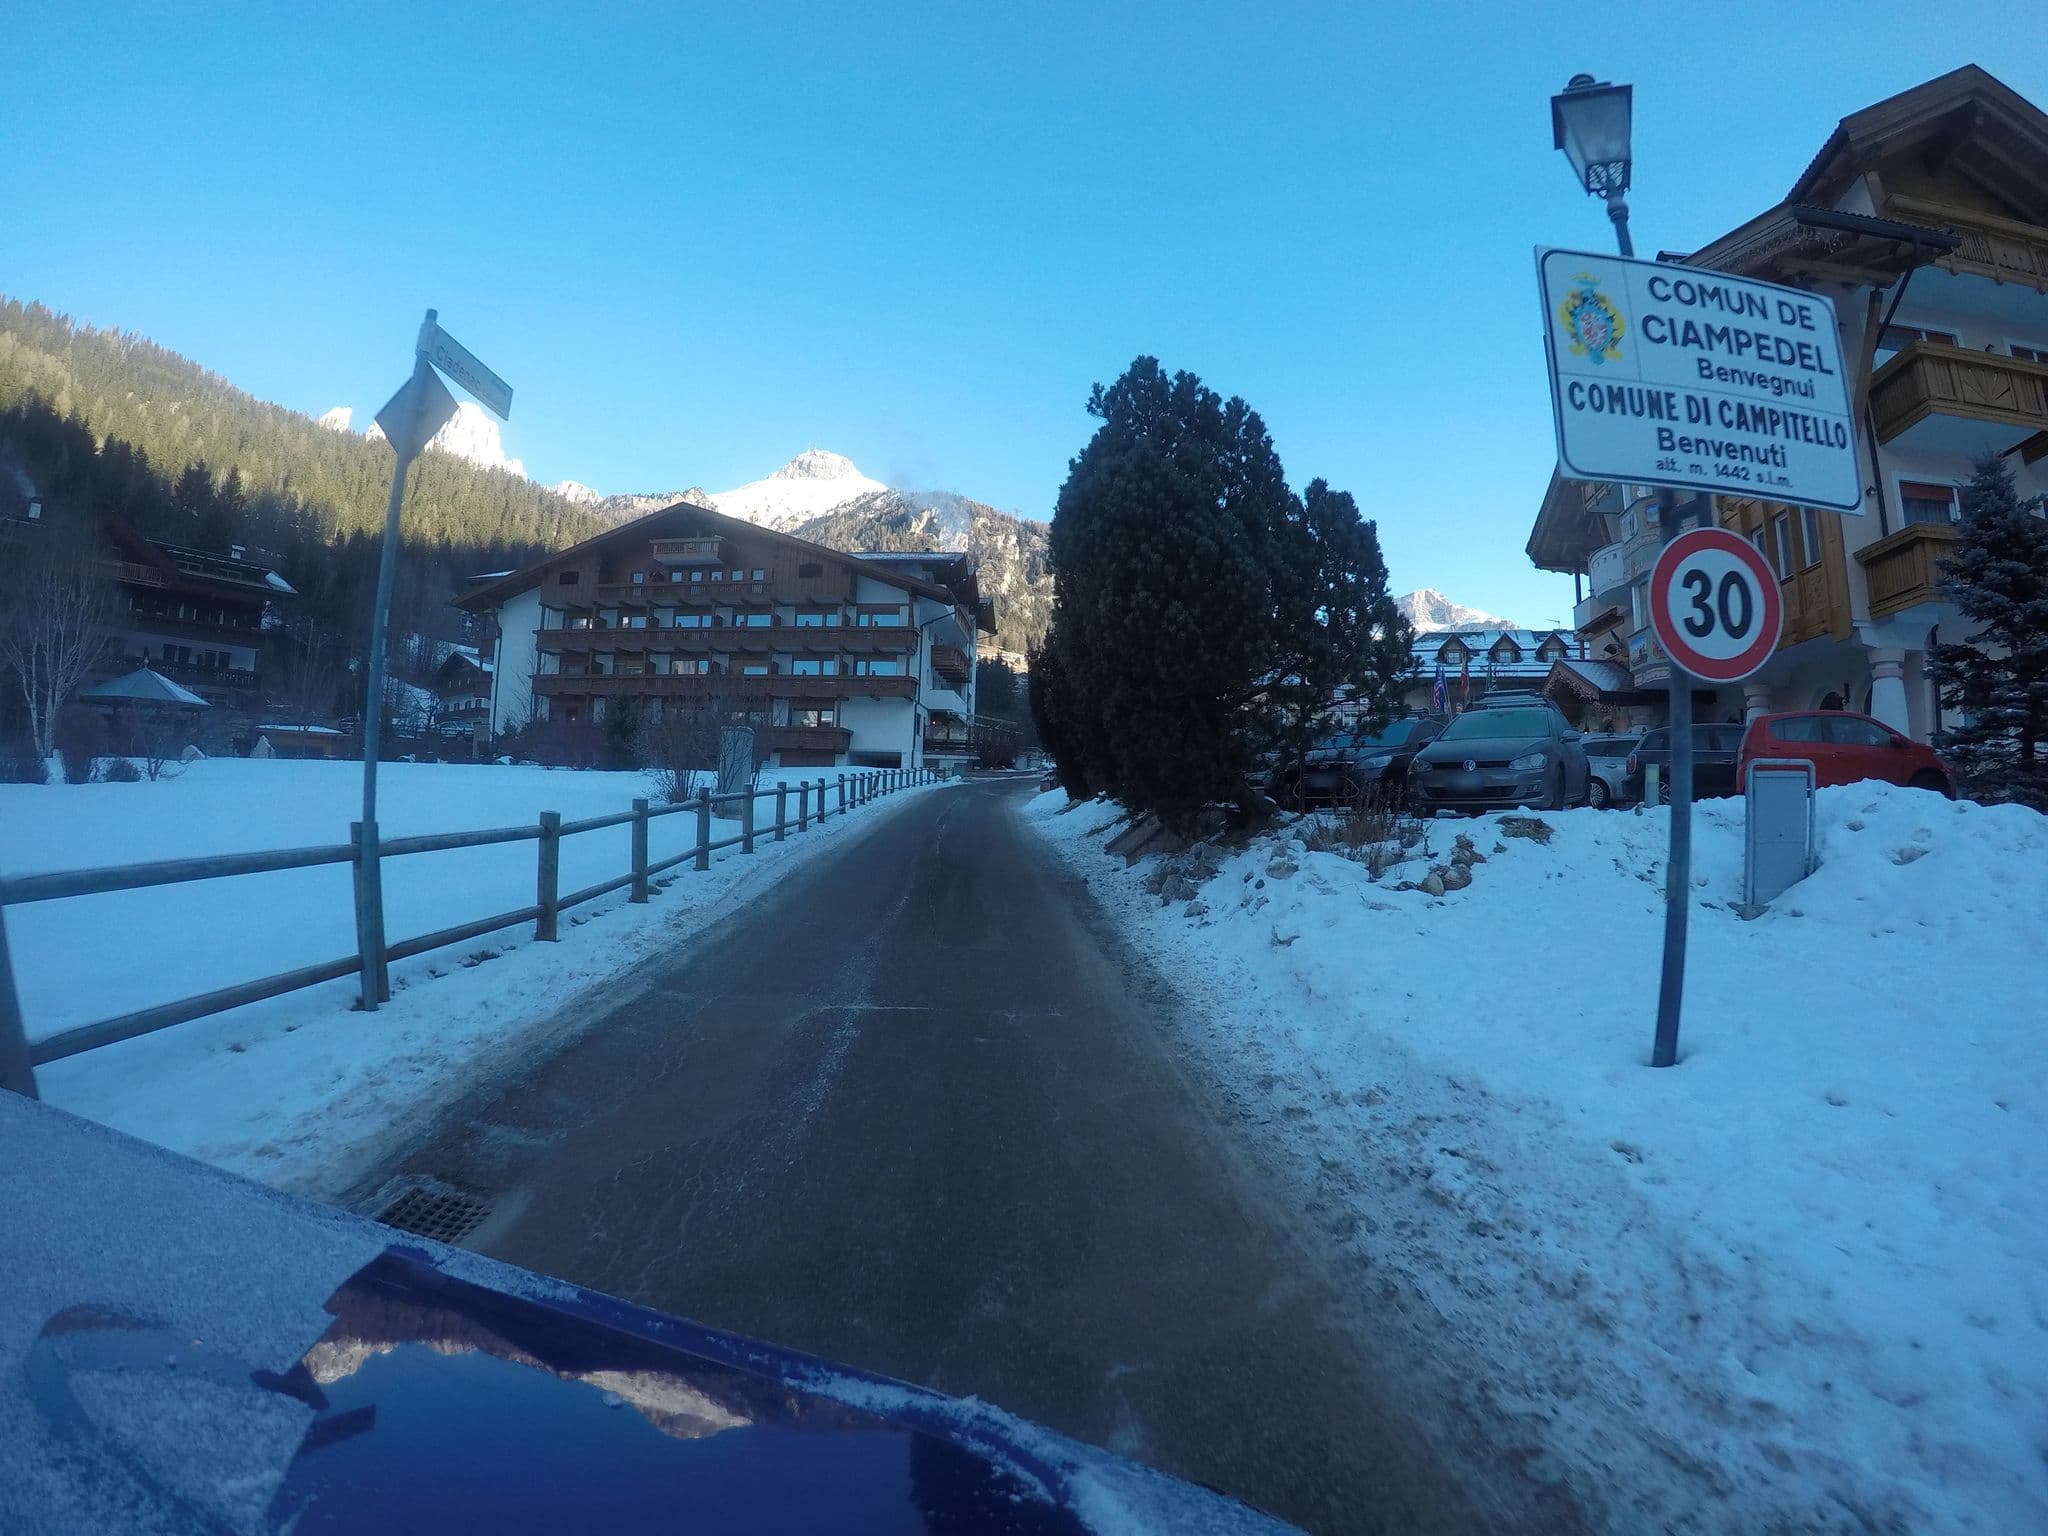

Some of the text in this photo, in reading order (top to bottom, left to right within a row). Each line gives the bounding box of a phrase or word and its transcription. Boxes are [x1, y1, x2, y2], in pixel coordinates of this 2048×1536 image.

[1649, 276, 1815, 331] COMUN DE
[1642, 315, 1834, 375] CIAMPEDEL
[1568, 381, 1847, 450] COMUNE DI CAMPITELLO
[1656, 427, 1787, 468] Benvenuti
[1656, 456, 1682, 473] alt.
[1689, 462, 1708, 476] m.
[1714, 463, 1751, 481] 1442
[1682, 569, 1752, 640] 30
